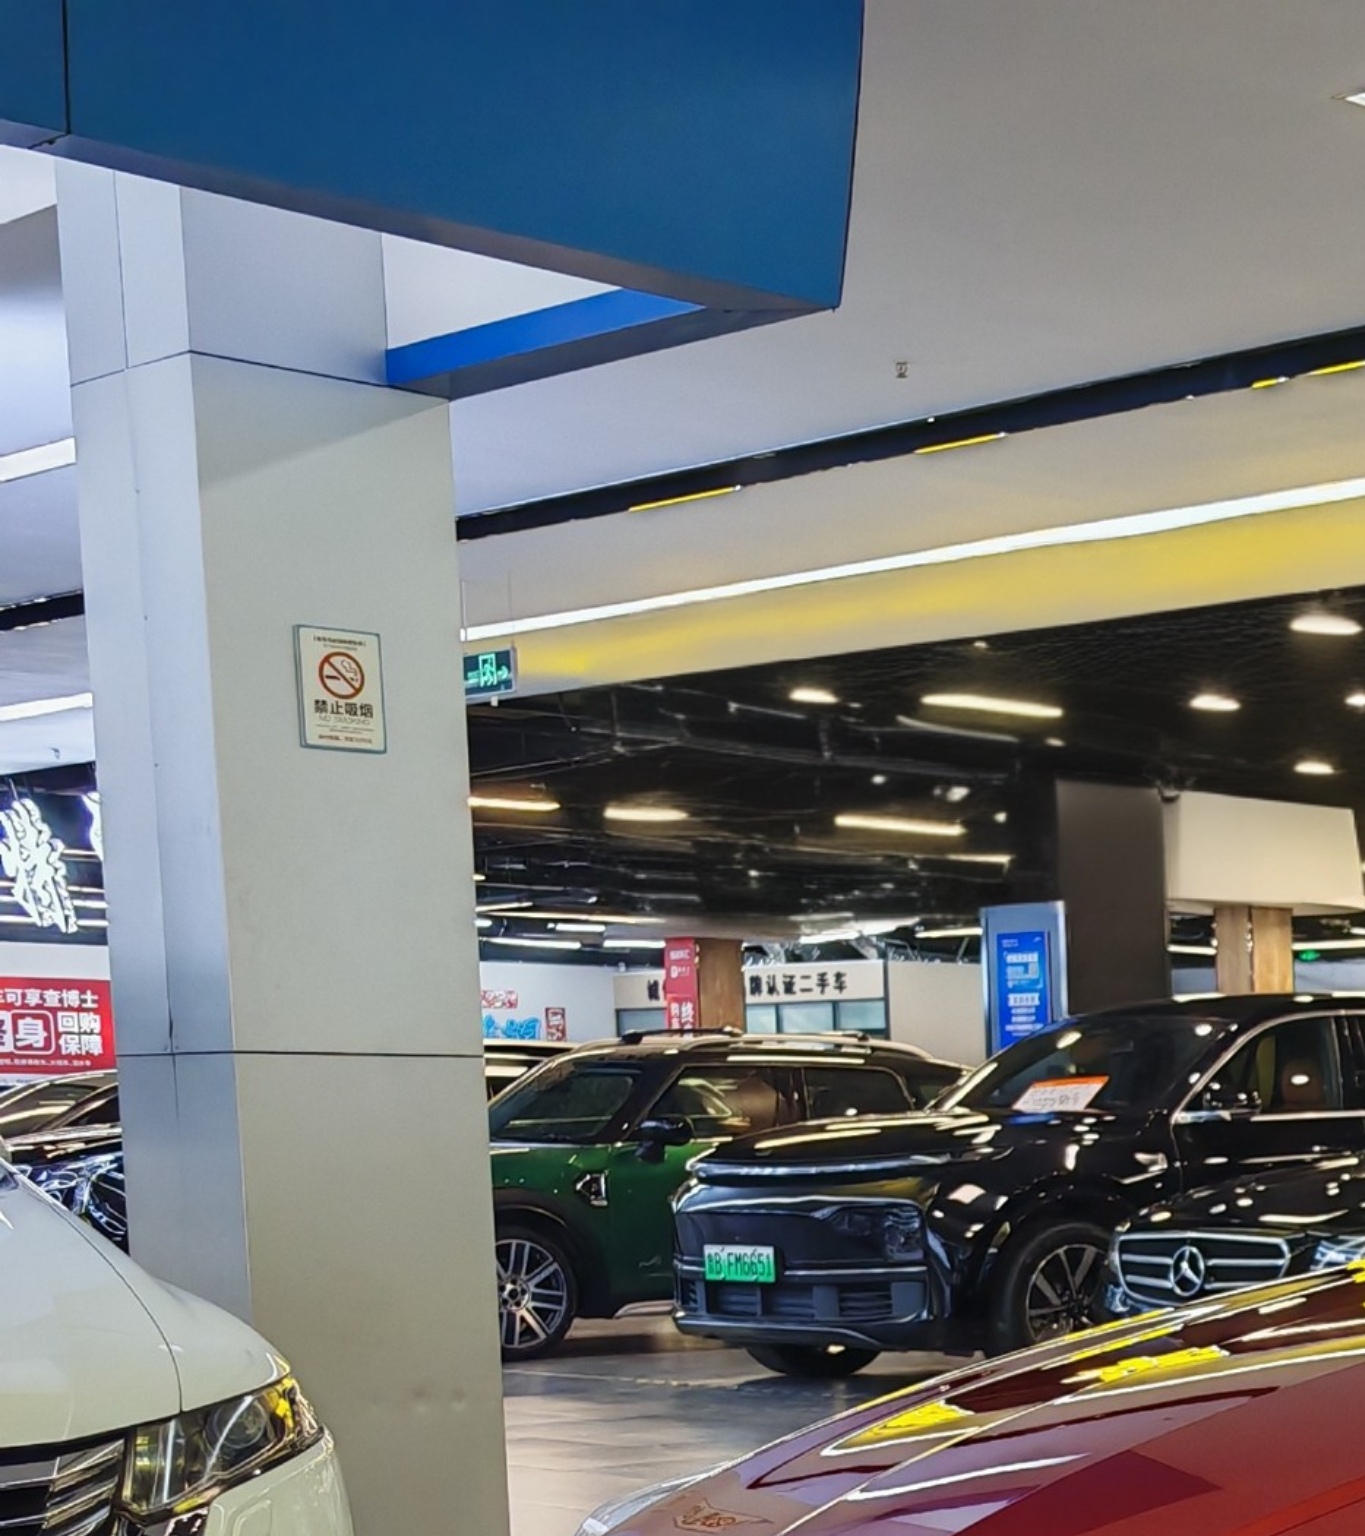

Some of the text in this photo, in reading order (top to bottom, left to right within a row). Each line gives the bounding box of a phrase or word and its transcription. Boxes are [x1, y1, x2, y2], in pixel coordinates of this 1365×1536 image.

[314, 699, 374, 719] 禁止吸烟
[57, 1011, 101, 1034] 回购
[59, 1034, 103, 1056] 保障
